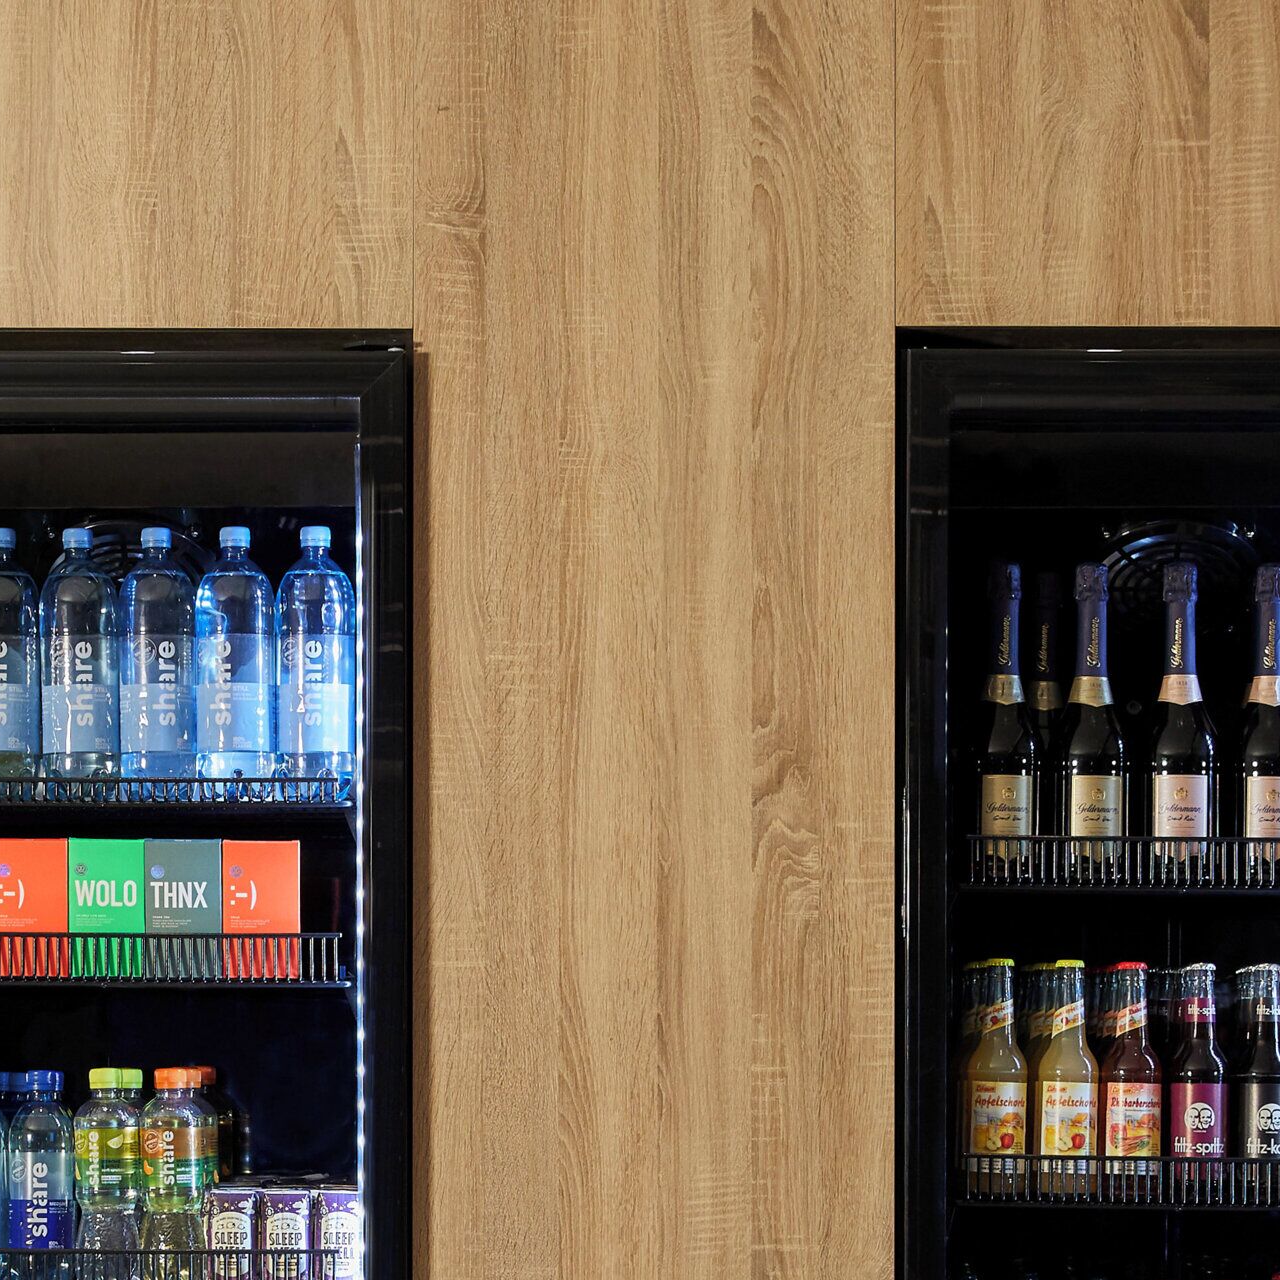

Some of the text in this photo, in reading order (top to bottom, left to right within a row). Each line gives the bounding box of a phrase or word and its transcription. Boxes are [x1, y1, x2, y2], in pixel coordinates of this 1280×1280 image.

[997, 615, 1012, 666] Geldermann
[1087, 616, 1100, 668] Geldermann
[1170, 617, 1184, 668] Geldermann
[1263, 618, 1276, 669] Geldermann
[70, 640, 94, 727] share
[152, 640, 176, 727] share
[209, 640, 232, 727] share
[299, 640, 323, 727] share
[986, 802, 1030, 815] Geldermann
[1076, 802, 1120, 815] Geldermann
[1158, 801, 1203, 815] Geldermann
[74, 879, 137, 907] WOLO
[150, 881, 209, 908] THNX
[230, 880, 258, 911] :-)
[86, 1131, 100, 1186] share
[161, 1130, 175, 1185] share
[1174, 1136, 1224, 1153] fritz-spritz
[26, 1161, 48, 1238] share
[214, 1231, 248, 1245] SLEEP
[269, 1232, 303, 1246] SLEEP
